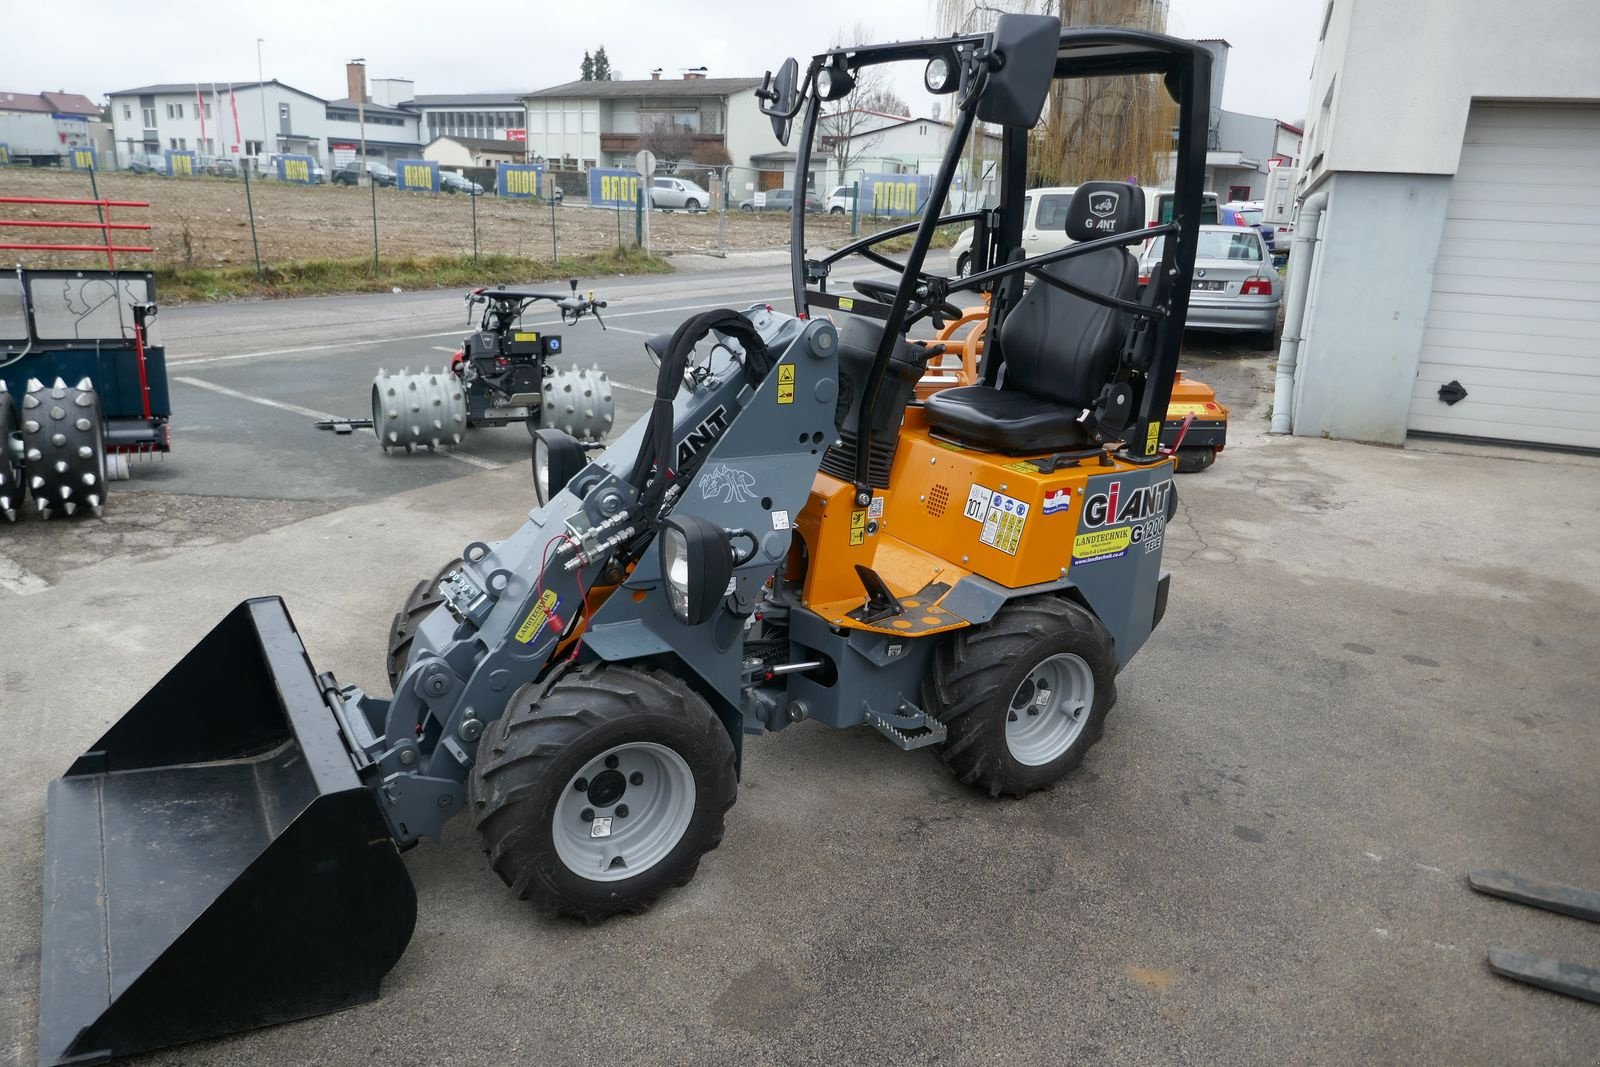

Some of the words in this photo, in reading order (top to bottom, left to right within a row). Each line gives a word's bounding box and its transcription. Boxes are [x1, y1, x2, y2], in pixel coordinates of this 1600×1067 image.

[968, 498, 981, 517] 101
[1076, 529, 1128, 547] LANDTECHNIK
[1130, 514, 1165, 544] G1200
[1145, 537, 1161, 554] TELE
